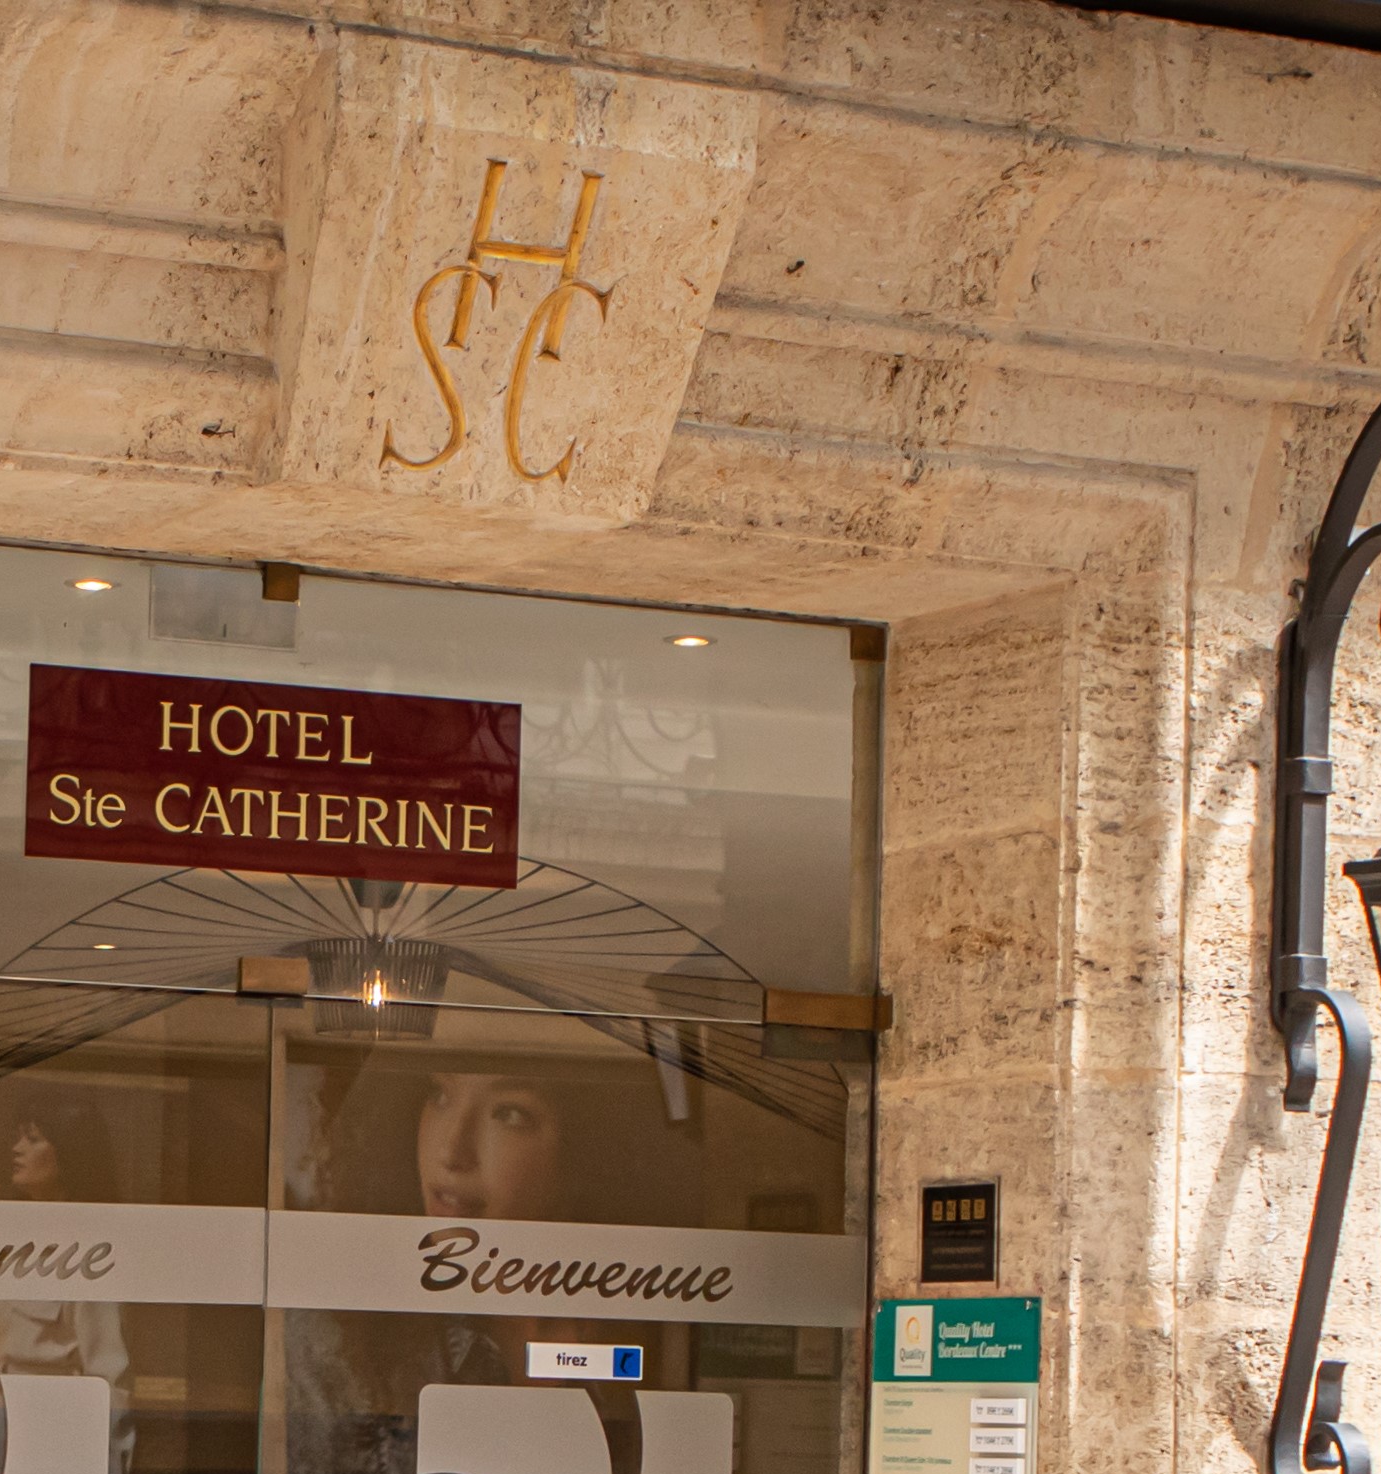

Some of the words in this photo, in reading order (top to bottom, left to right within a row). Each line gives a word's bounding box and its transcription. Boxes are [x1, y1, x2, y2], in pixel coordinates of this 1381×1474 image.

[158, 701, 374, 765] HOTEL
[48, 773, 127, 829] Ste
[154, 782, 495, 854] CATHERINE
[417, 1226, 735, 1303] Bienvenue
[556, 1352, 588, 1368] tirez
